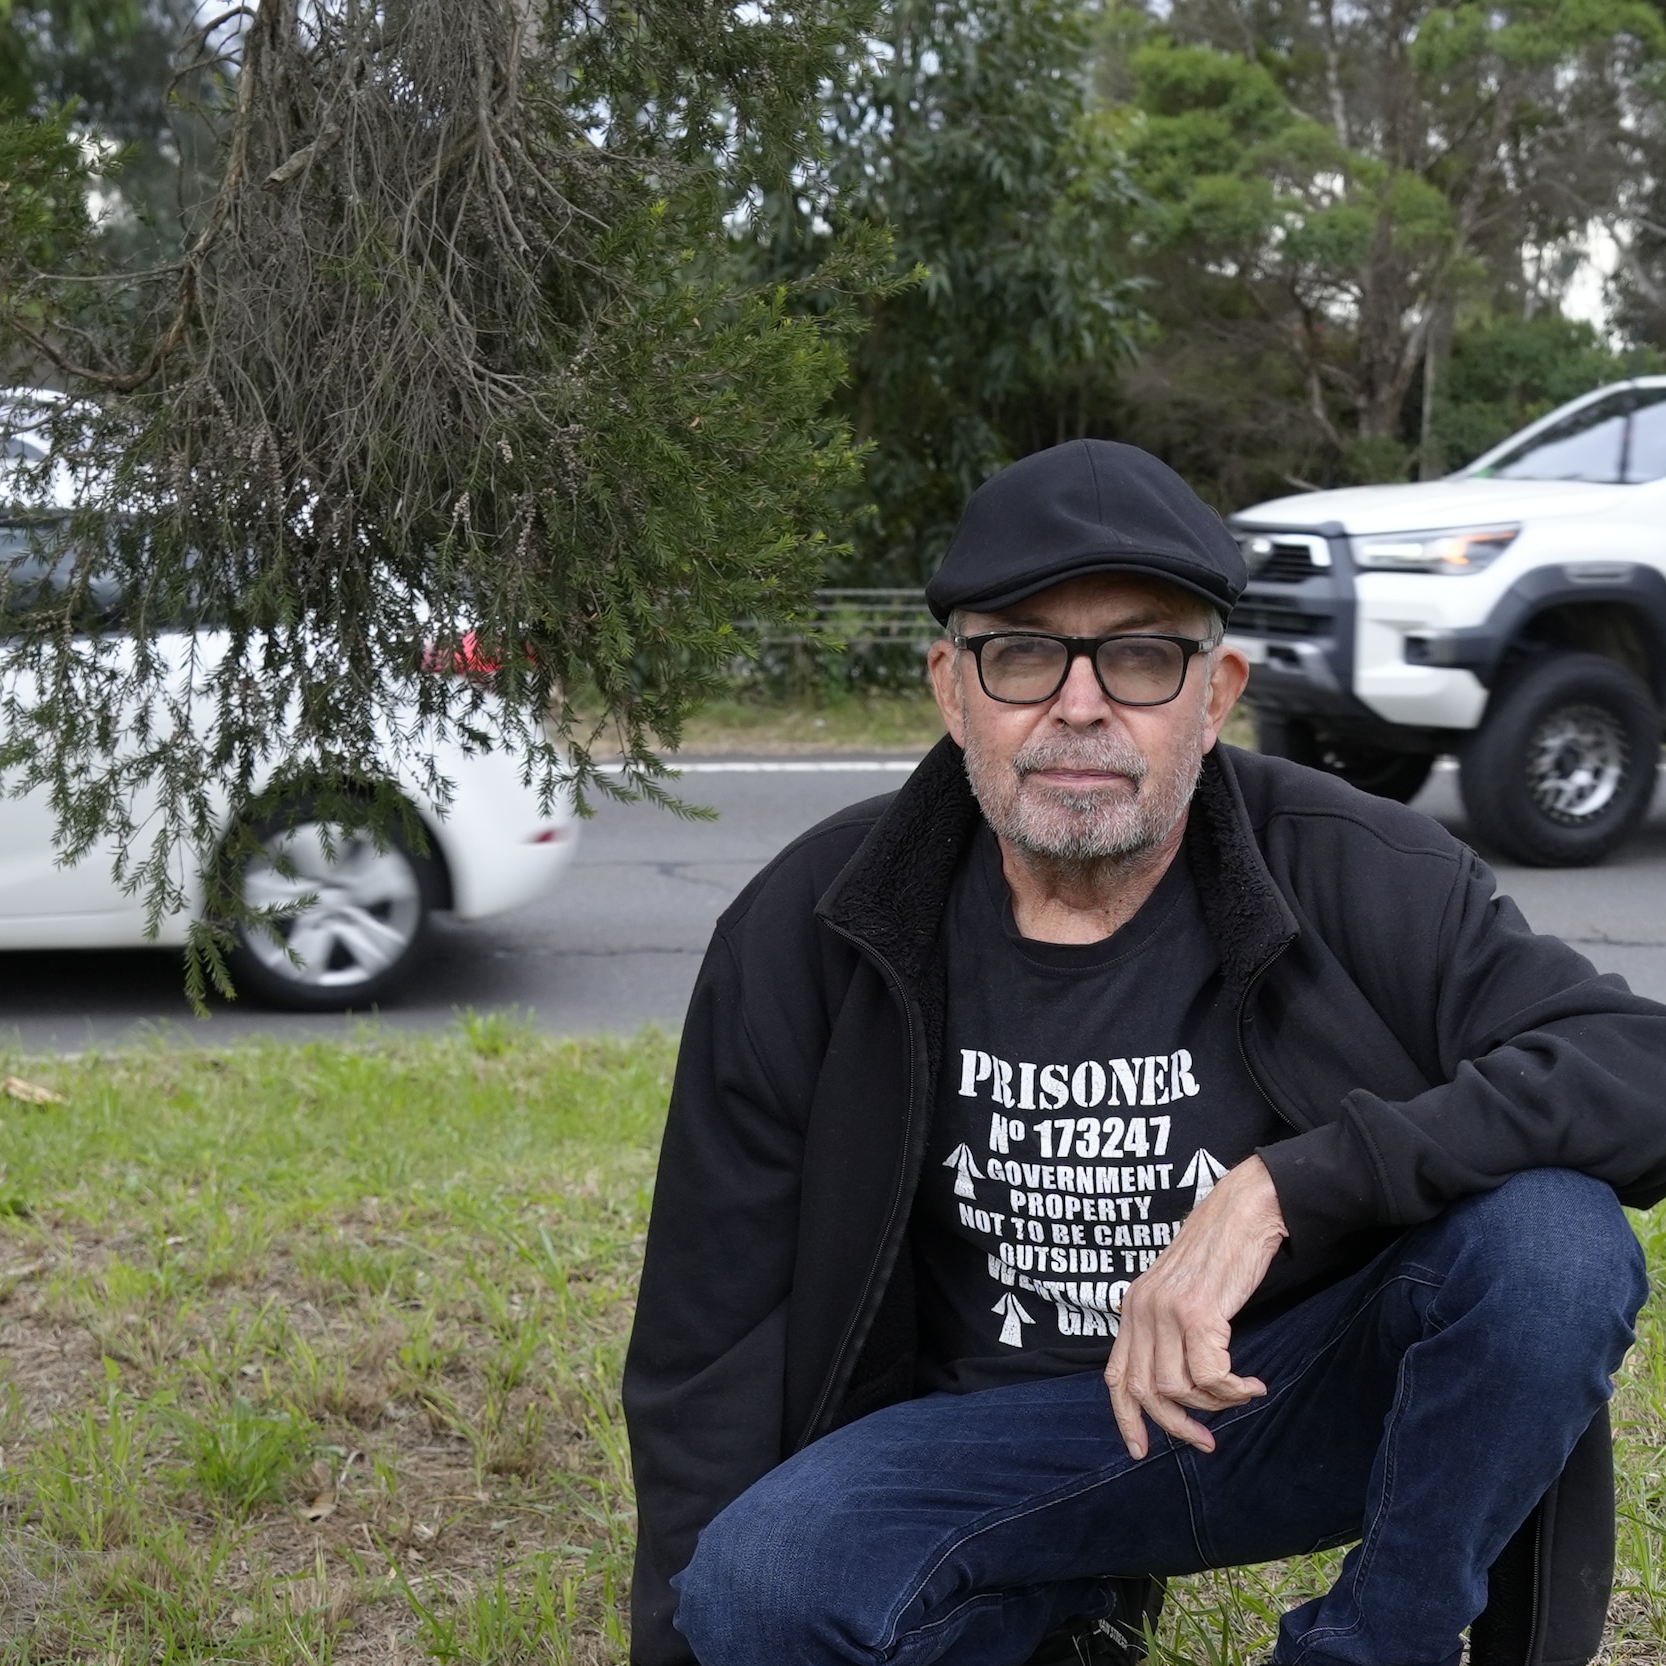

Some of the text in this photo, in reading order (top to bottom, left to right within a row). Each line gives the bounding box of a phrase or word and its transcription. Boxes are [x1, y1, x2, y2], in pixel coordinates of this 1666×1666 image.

[958, 1048, 1200, 1110] PRISONER
[1033, 1115, 1171, 1158] 173247
[986, 1158, 1174, 1194] GOVERNMENT
[958, 1202, 1186, 1247] NOT TO BE CARRI
[1009, 1188, 1152, 1222] PROPERTY
[999, 1242, 1165, 1273] OUTSIDE TH
